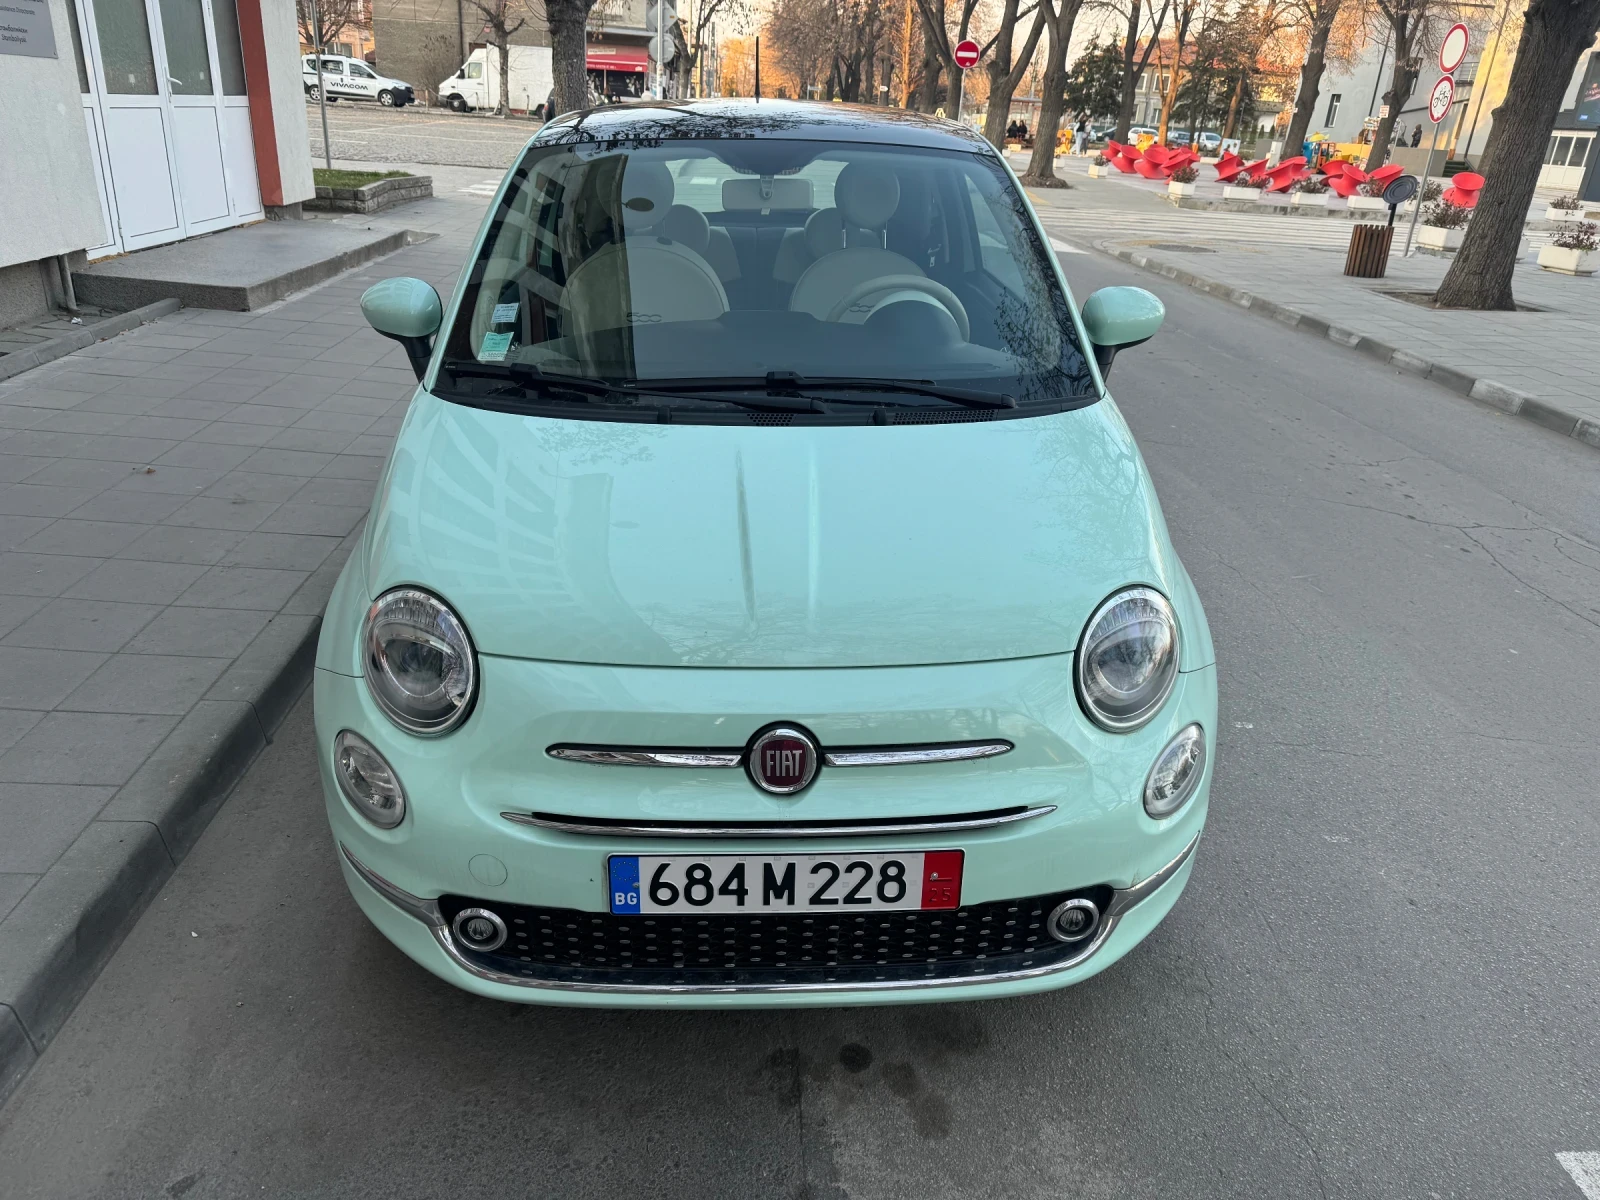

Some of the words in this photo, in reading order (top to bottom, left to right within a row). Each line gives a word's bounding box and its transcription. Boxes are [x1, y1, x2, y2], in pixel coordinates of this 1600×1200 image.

[330, 82, 369, 91] VIVACOM
[766, 750, 803, 777] FIAT
[649, 861, 749, 907] 684
[808, 859, 907, 905] 228
[615, 892, 637, 905] BG
